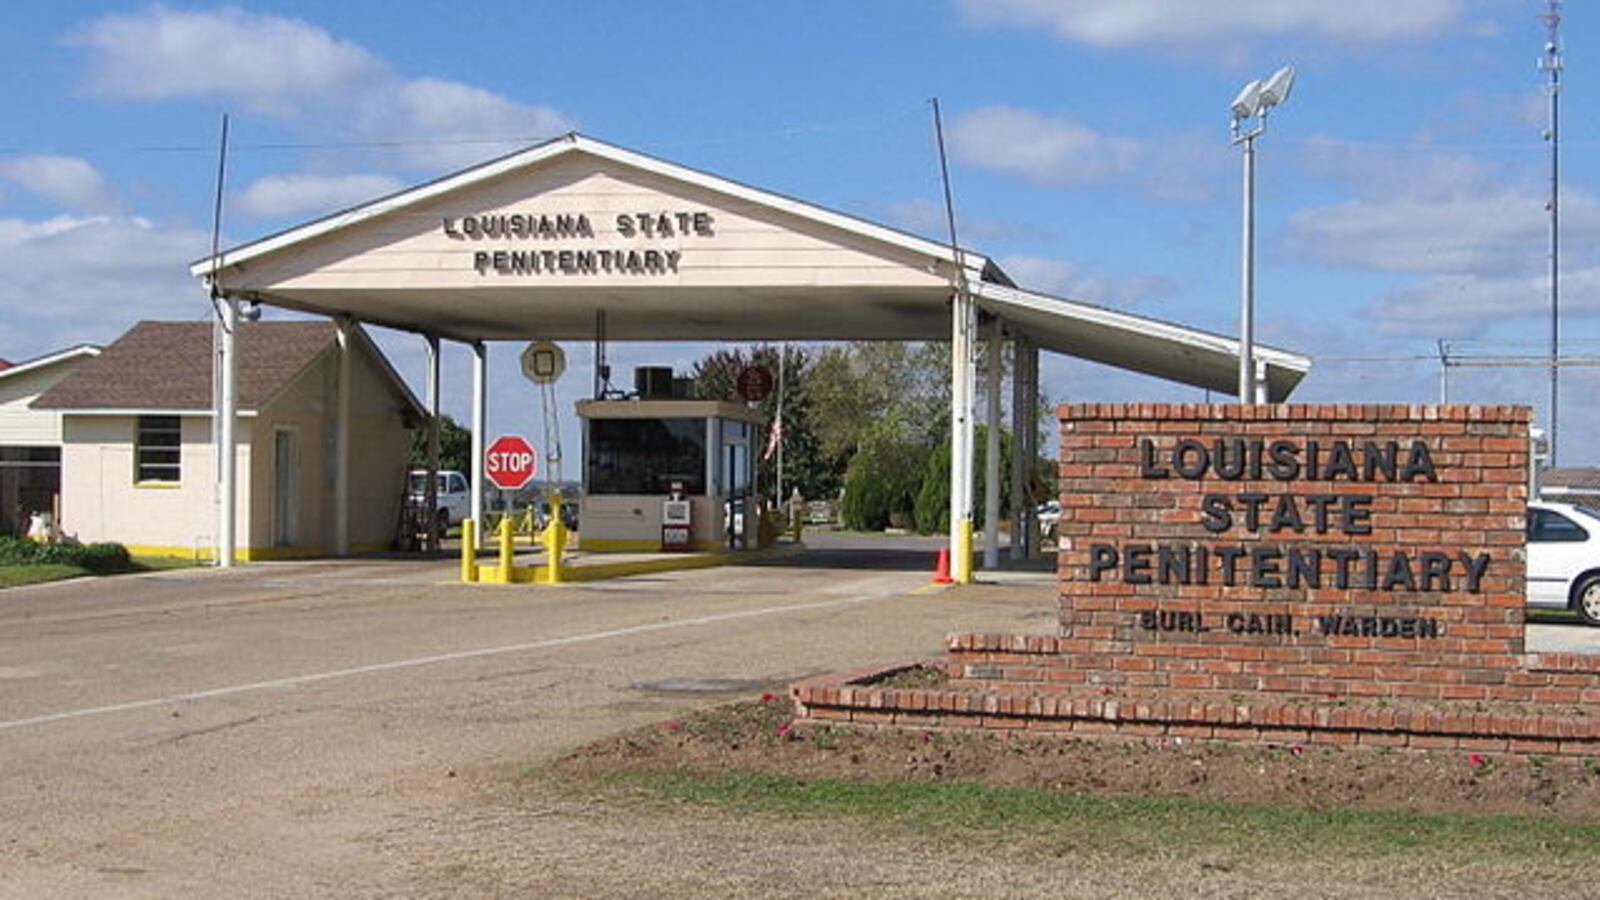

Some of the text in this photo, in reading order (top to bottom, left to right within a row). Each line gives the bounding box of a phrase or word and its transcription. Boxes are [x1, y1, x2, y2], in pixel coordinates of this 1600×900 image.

[443, 212, 713, 237] LOUISIANA STATE
[474, 250, 680, 273] PENITENTIARY
[488, 452, 532, 472] STOP
[1140, 438, 1438, 482] LOUISIANA
[1201, 493, 1374, 535] STATE
[1089, 544, 1491, 593] PENITENTIARY
[1319, 615, 1438, 640] WARDEN
